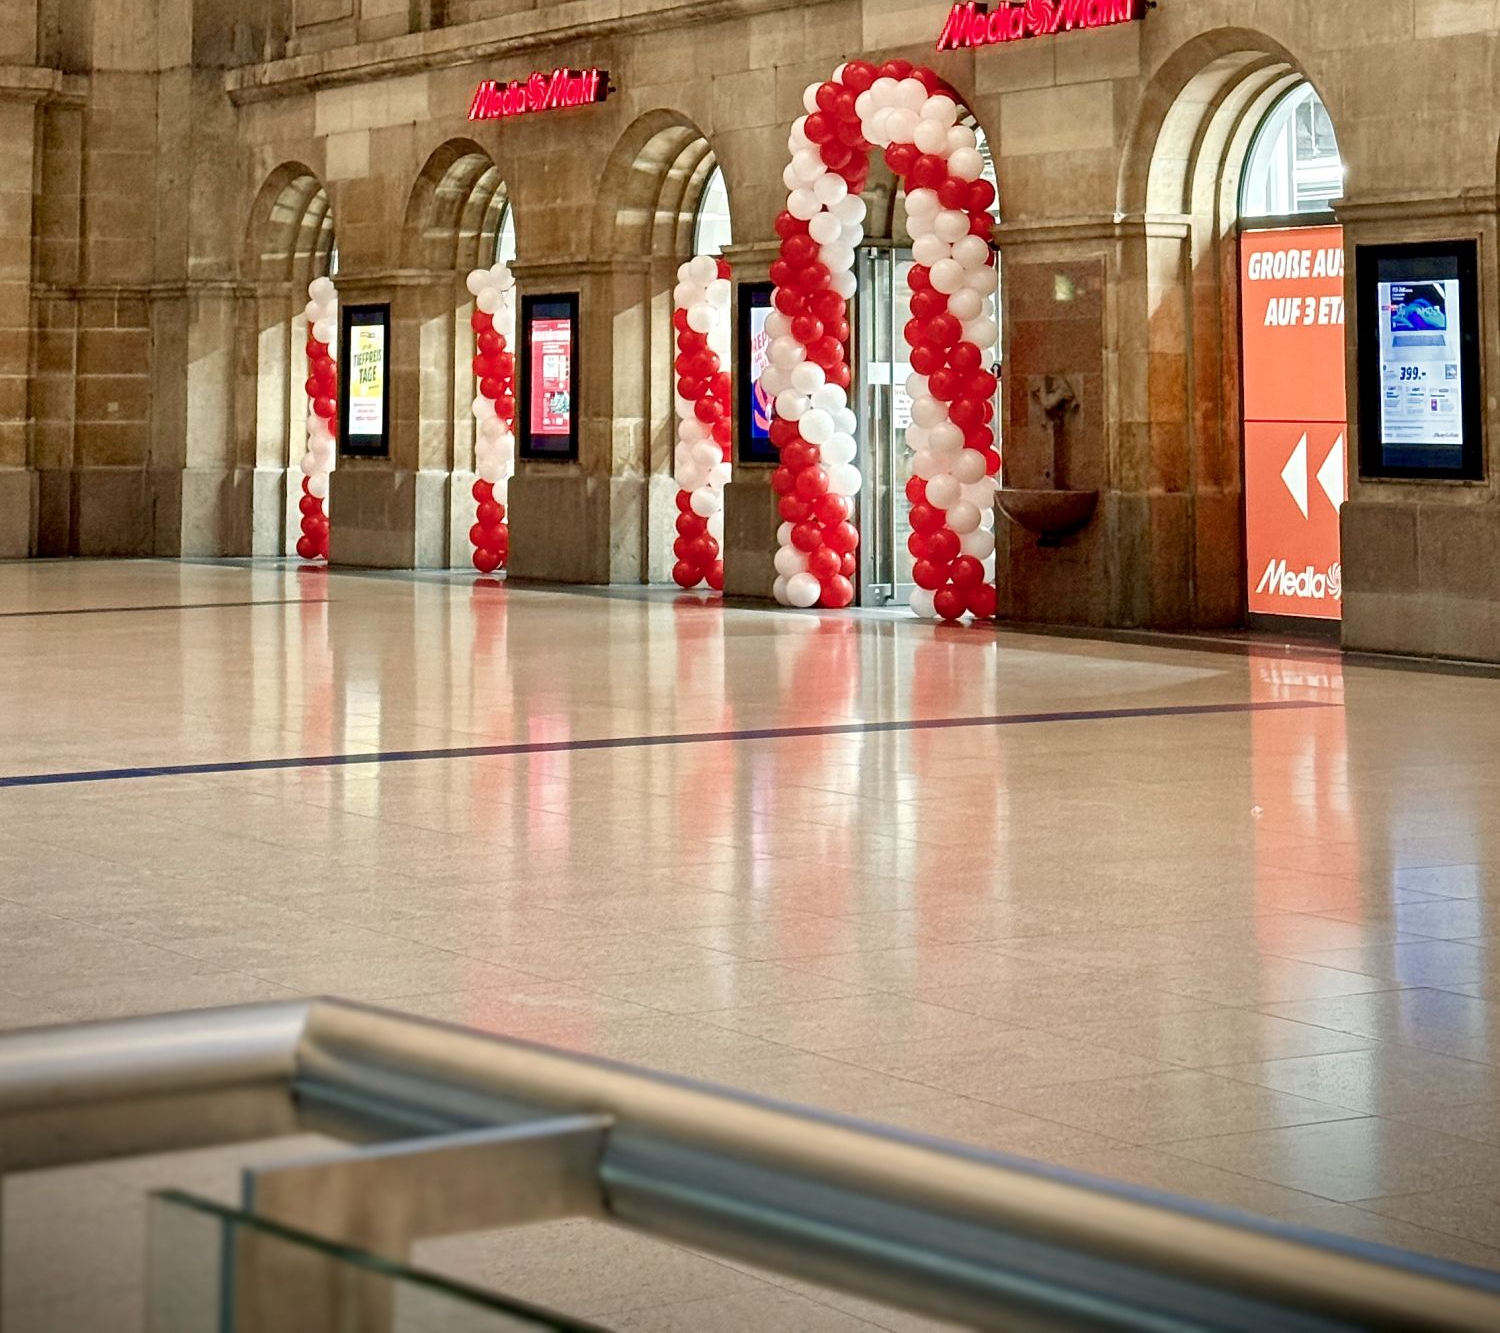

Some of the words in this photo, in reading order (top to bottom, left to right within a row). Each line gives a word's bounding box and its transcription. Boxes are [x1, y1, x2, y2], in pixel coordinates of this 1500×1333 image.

[936, 1, 1025, 50] Media
[1264, 296, 1302, 326] AUF
[1303, 296, 1316, 325] 3
[353, 349, 382, 367] TIEFPREIS
[359, 366, 377, 384] TAGE
[1400, 366, 1426, 380] 399.-
[1255, 559, 1326, 598] Media
